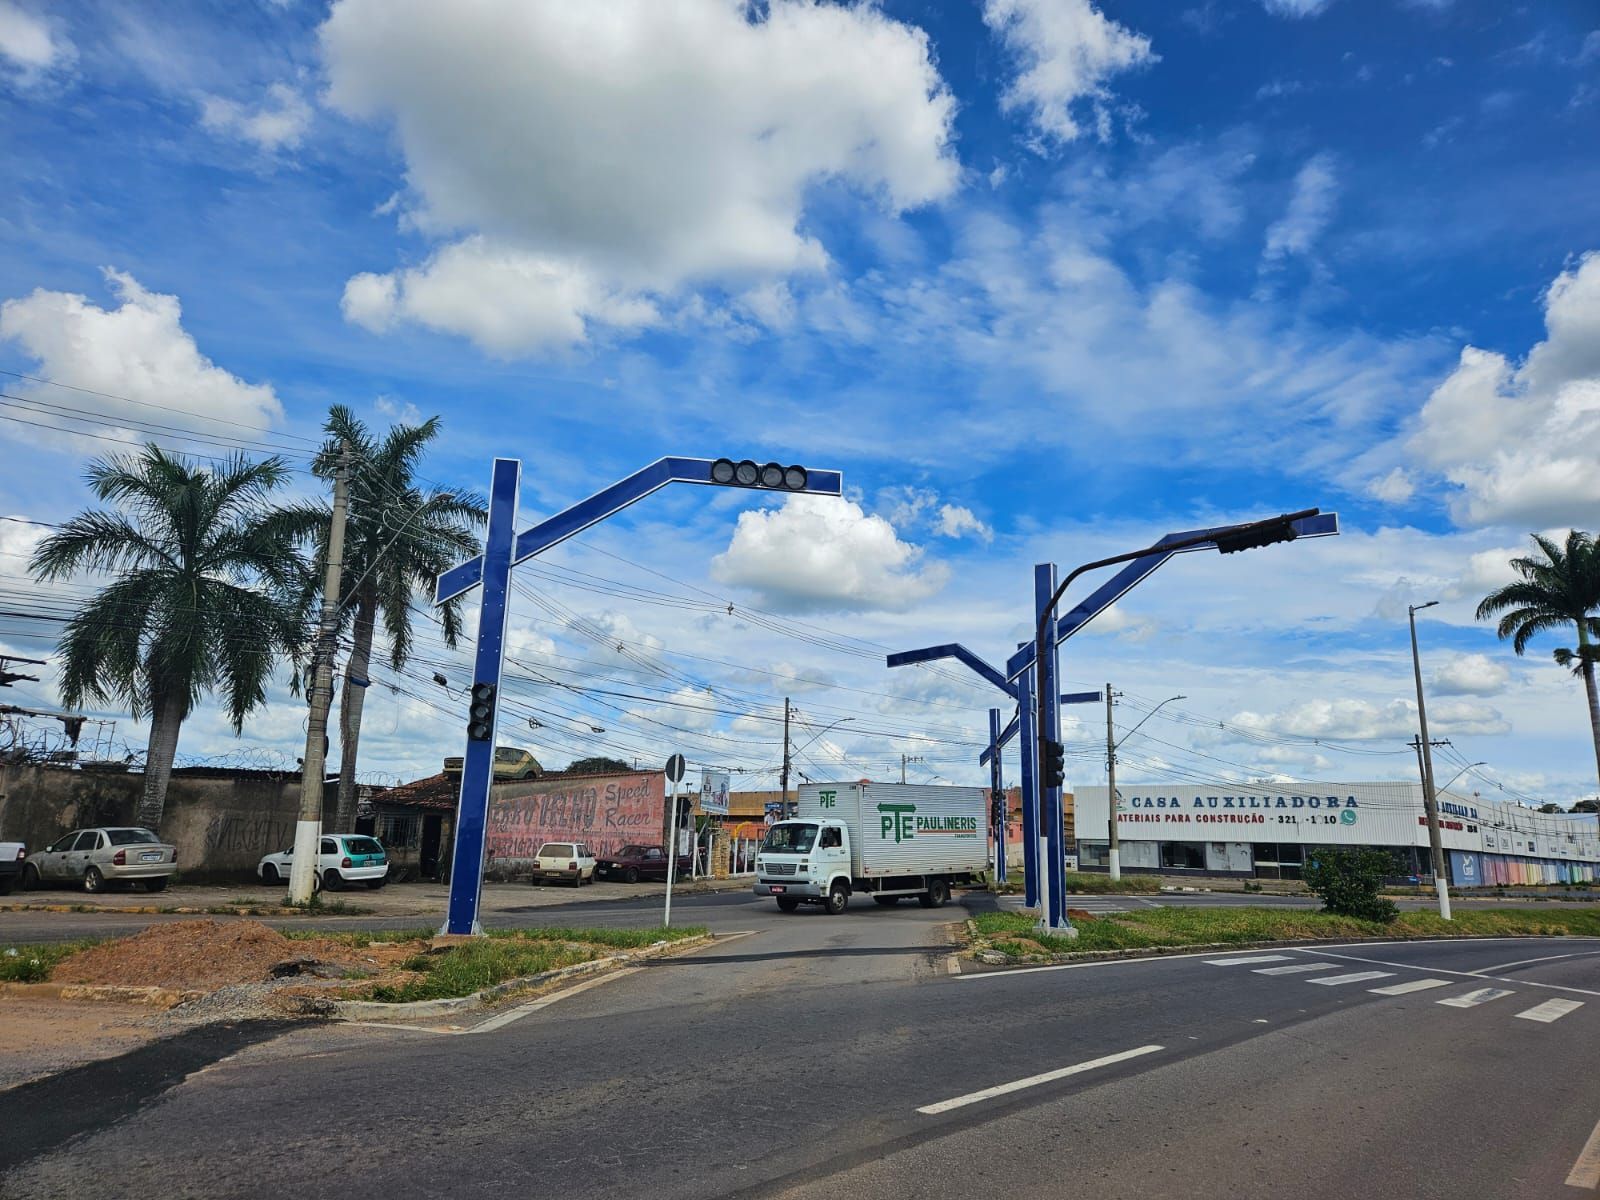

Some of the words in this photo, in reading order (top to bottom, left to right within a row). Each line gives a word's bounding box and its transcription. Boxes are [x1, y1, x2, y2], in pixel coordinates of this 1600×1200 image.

[605, 778, 650, 808] Speed
[819, 790, 837, 808] PTE
[1132, 796, 1181, 808] CASA
[1193, 796, 1359, 808] AUXILIADORA
[605, 807, 651, 827] Racer
[877, 802, 916, 844] PTE
[917, 816, 977, 830] PAULINERIS
[1116, 814, 1161, 823] ATERIAIS
[1165, 814, 1192, 823] PARA
[1196, 812, 1265, 824] CONSTRUÇÃO
